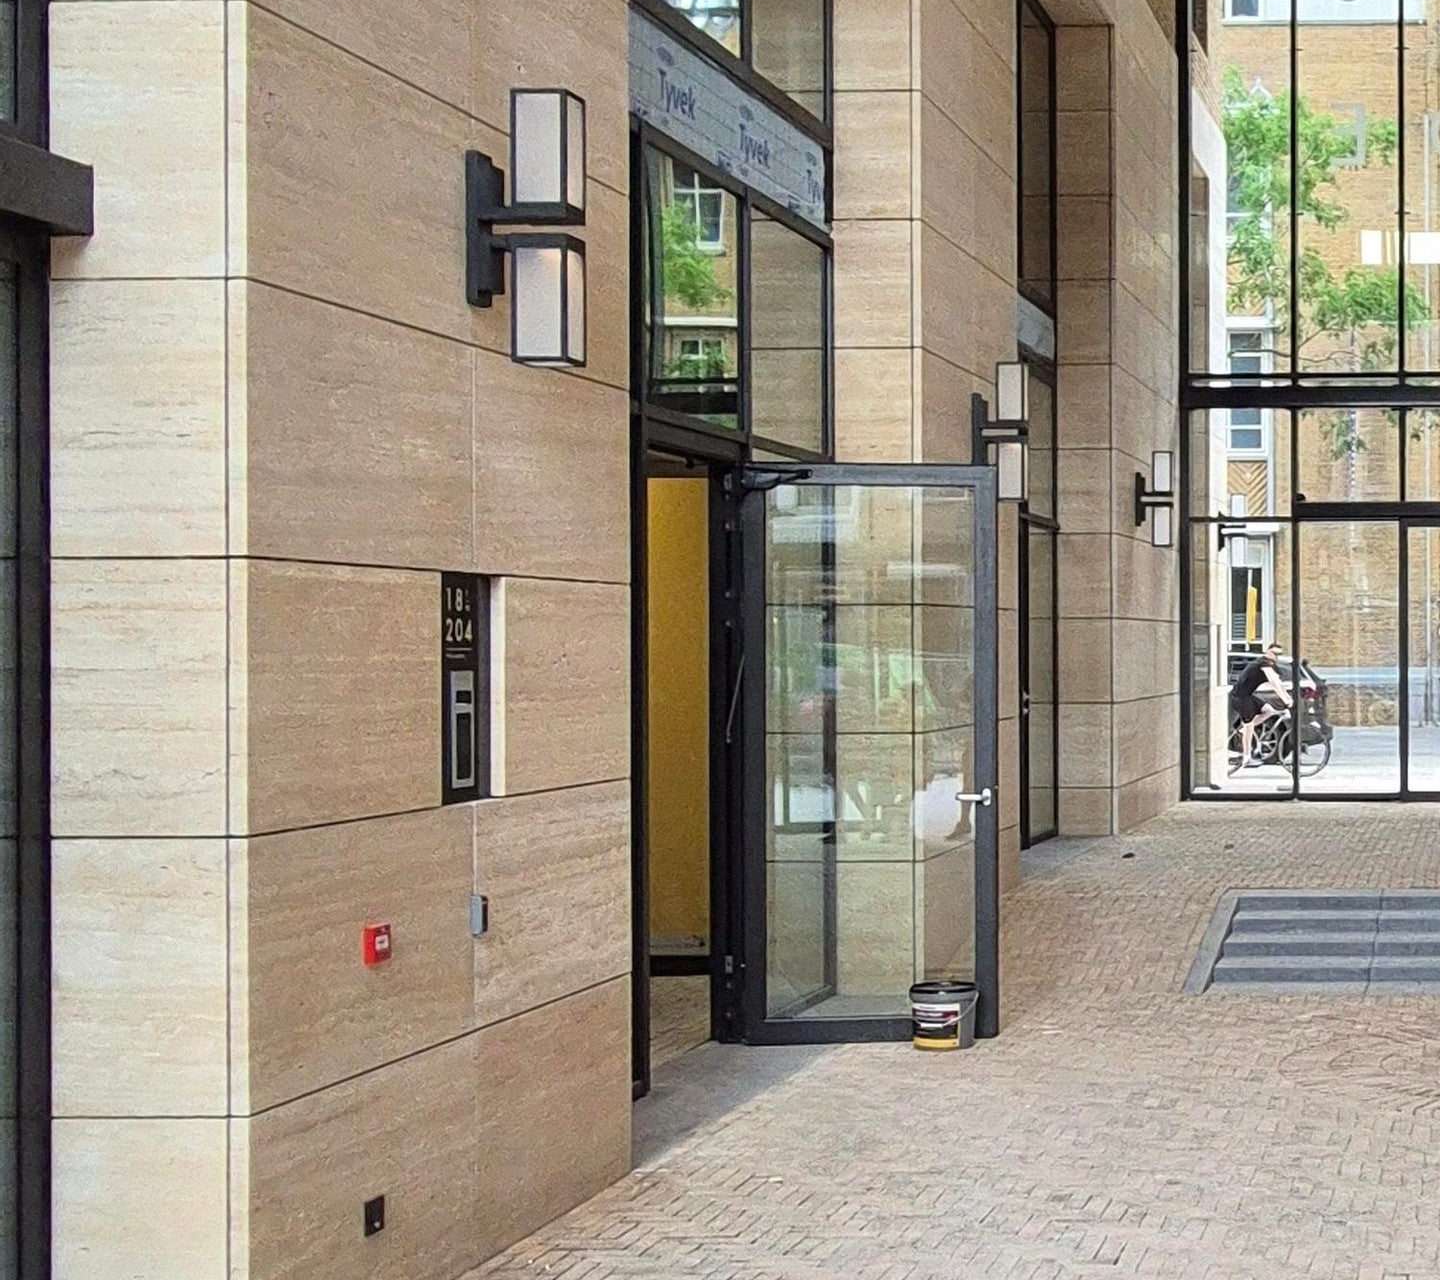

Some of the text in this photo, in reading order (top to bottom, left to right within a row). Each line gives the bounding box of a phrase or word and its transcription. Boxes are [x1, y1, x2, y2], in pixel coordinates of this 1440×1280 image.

[658, 67, 696, 120] Tyvek
[738, 123, 770, 170] Tyvek
[445, 618, 473, 642] 204
